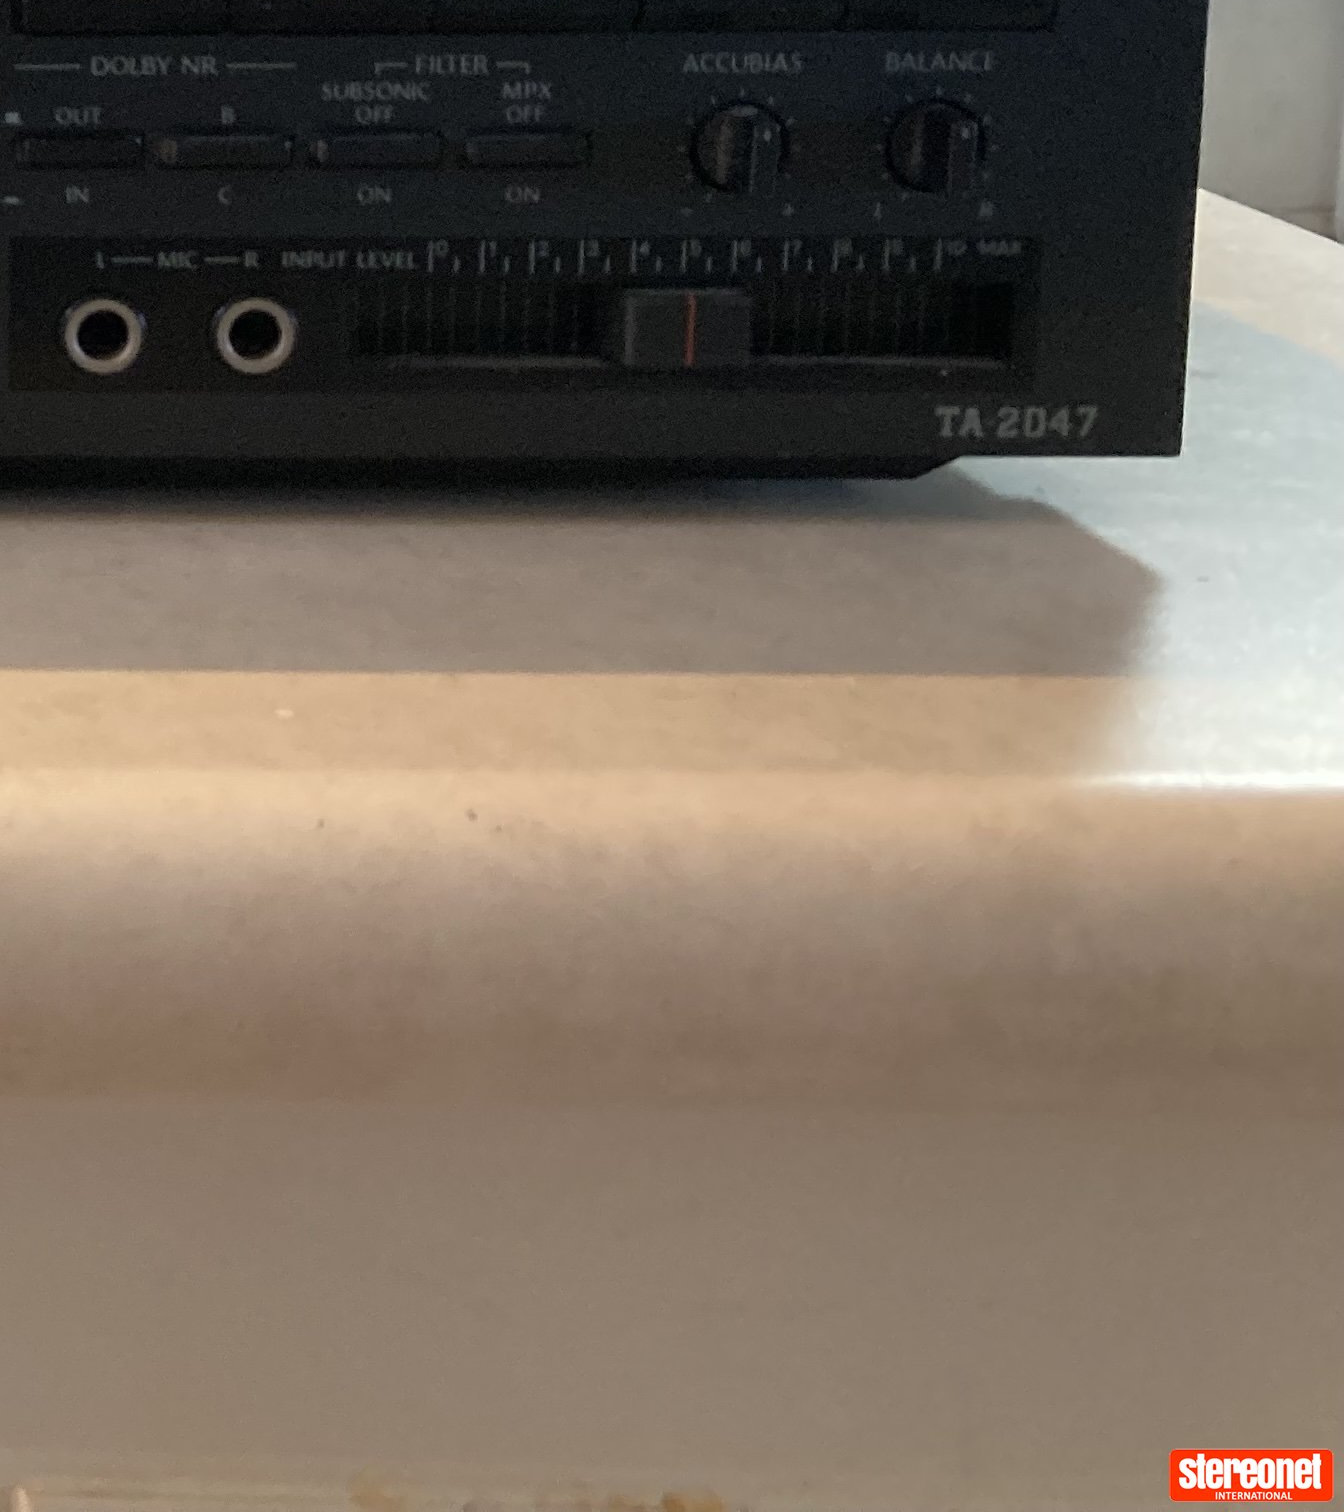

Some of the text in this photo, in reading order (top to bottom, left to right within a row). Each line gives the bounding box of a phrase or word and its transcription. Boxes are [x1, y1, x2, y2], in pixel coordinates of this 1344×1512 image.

[90, 55, 219, 76] DOLBY NR
[414, 54, 489, 76] FILTER
[681, 49, 805, 75] ACCUBIAS
[884, 49, 996, 74] BALANCE
[321, 80, 430, 102] SUBSONIC
[502, 80, 552, 100] MPX
[53, 105, 102, 126] OUT
[355, 103, 394, 124] OFF
[506, 103, 546, 124] OFF
[65, 185, 90, 204] IN
[357, 184, 392, 206] ON
[504, 184, 541, 205] ON
[157, 250, 199, 269] MIC
[281, 249, 415, 270] INPUT LEVEL
